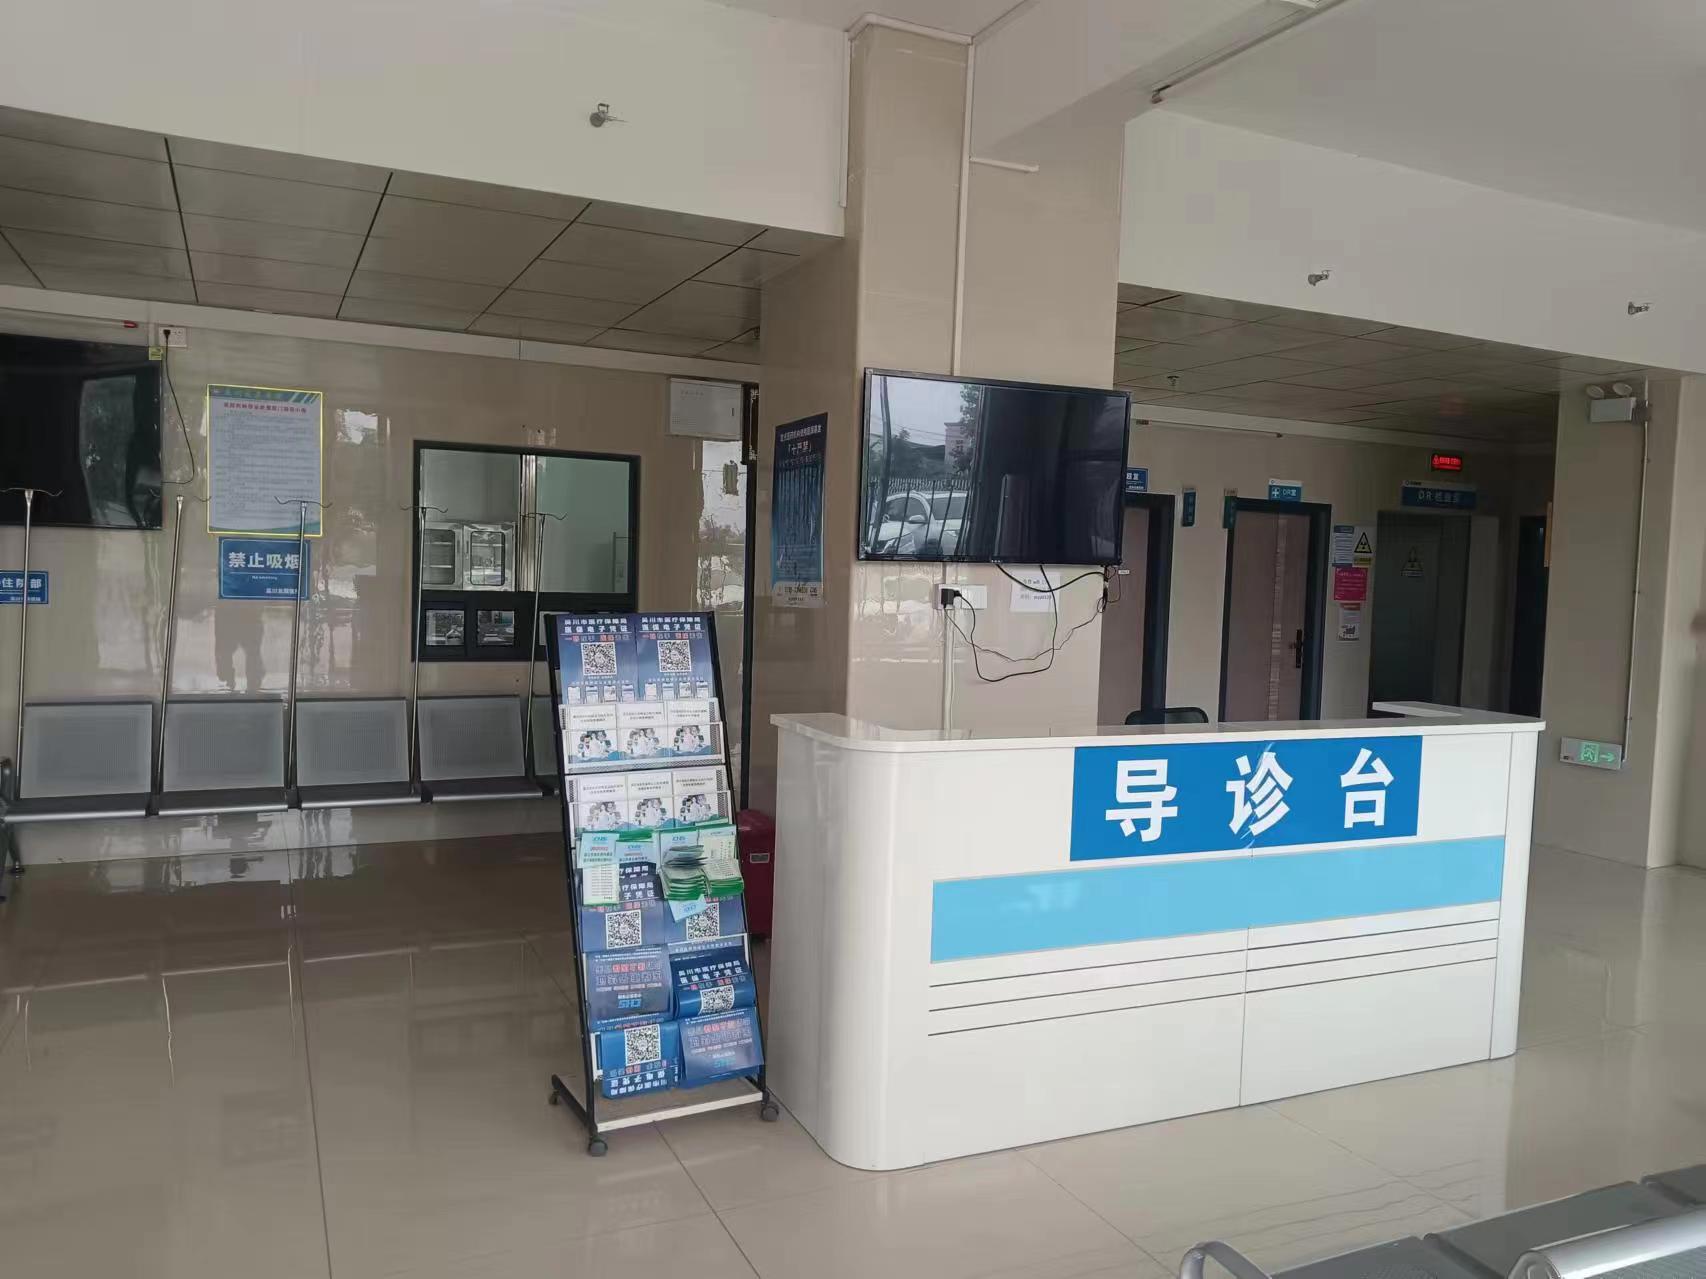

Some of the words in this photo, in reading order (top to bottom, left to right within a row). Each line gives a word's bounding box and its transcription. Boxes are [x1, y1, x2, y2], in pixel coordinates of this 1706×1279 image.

[228, 551, 300, 569] 禁止吸烟
[1105, 748, 1395, 842] 导诊台
